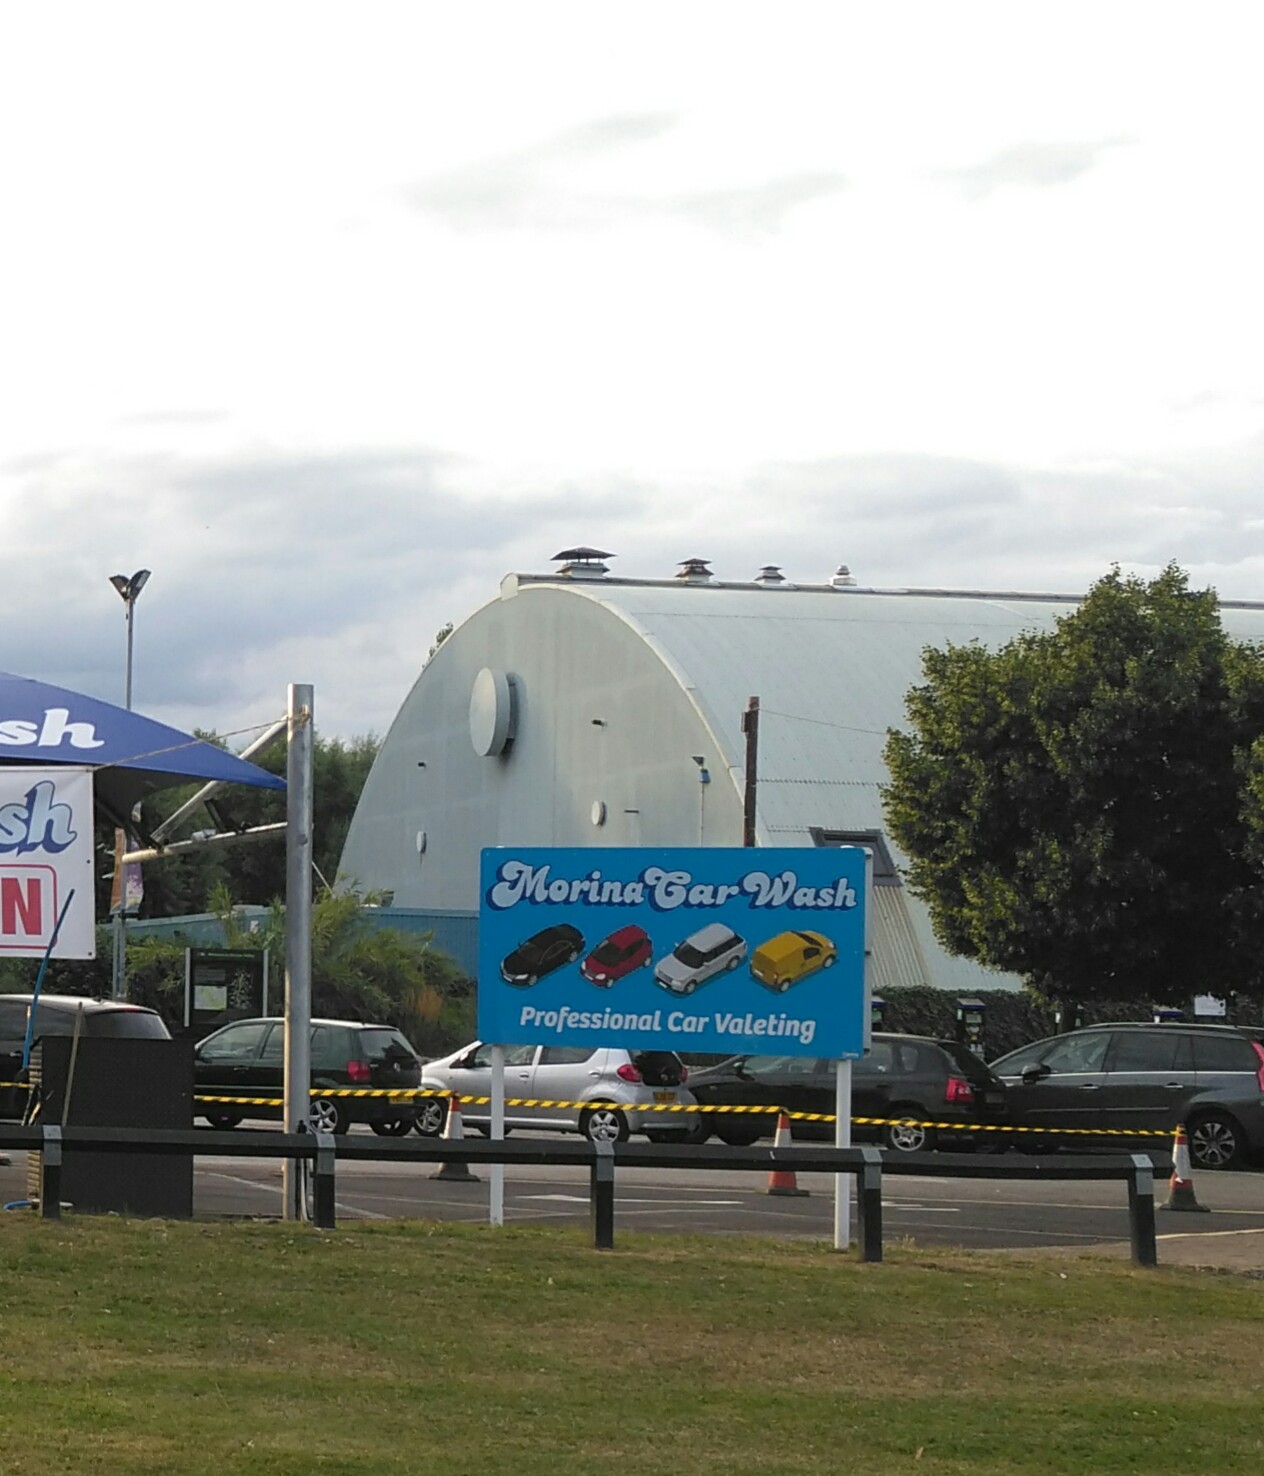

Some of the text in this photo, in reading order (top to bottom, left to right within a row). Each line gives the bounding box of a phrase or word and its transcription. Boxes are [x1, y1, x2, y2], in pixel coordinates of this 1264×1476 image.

[488, 859, 857, 912] Morina Car Wash
[520, 1006, 817, 1045] Professional Car Valeting
